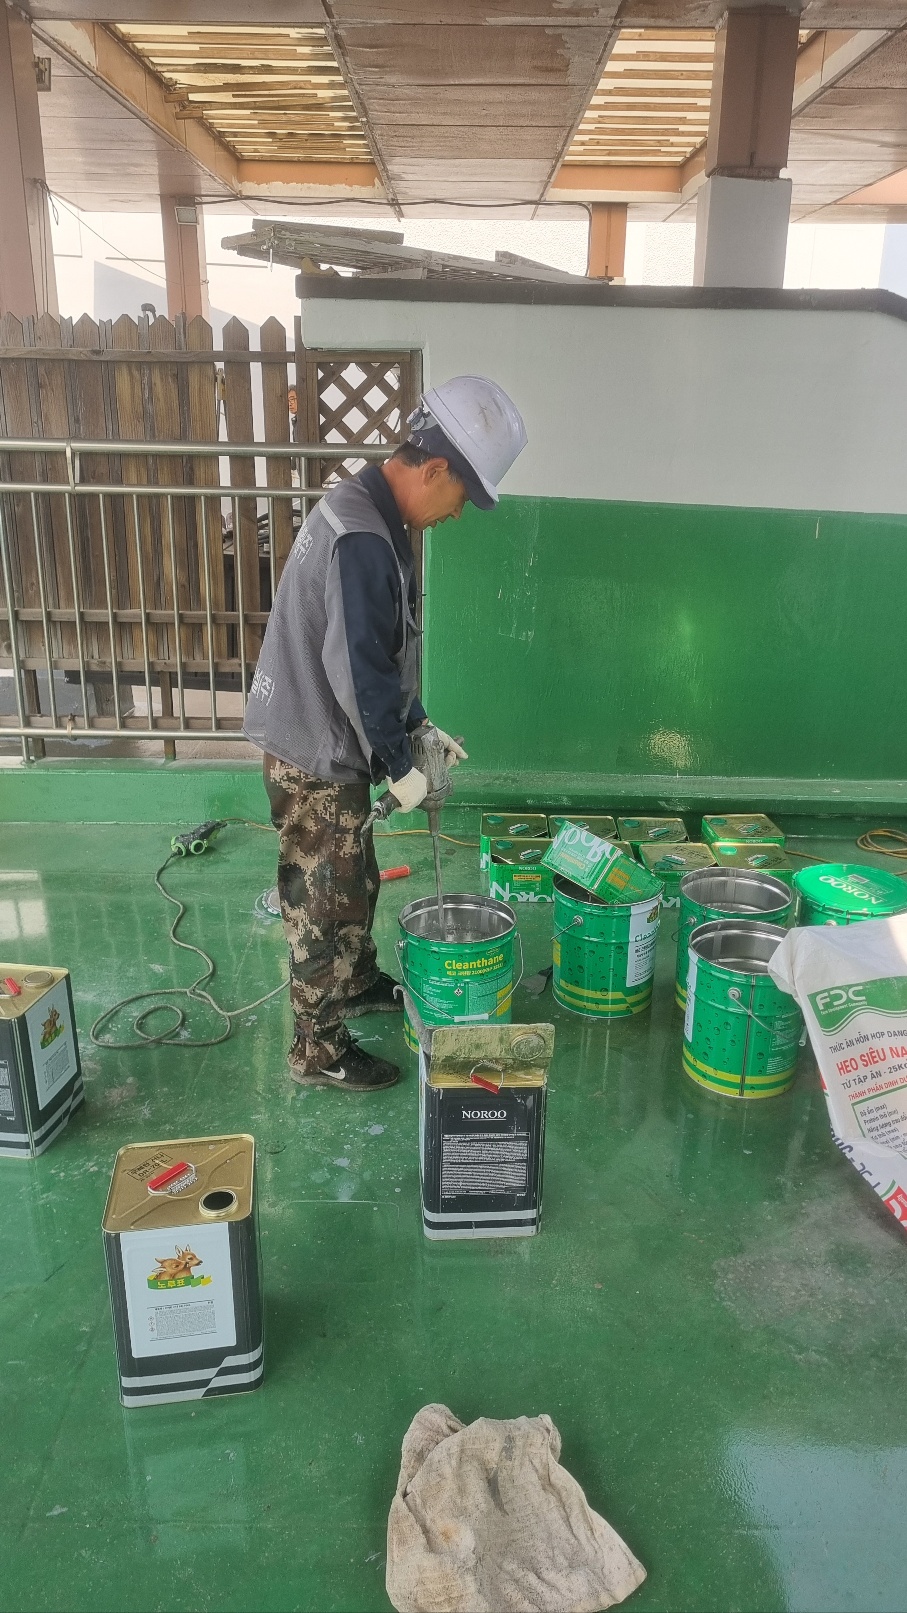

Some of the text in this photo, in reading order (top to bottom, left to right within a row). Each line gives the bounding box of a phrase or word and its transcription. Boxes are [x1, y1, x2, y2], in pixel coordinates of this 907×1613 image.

[819, 876, 884, 905] NOROO
[444, 953, 504, 970] Cleanthane
[815, 985, 866, 1011] FDC
[836, 1057, 859, 1077] HEO
[859, 1047, 887, 1068] SIÊU
[461, 1110, 507, 1119] NOROO
[157, 1279, 186, 1289] 노루표
